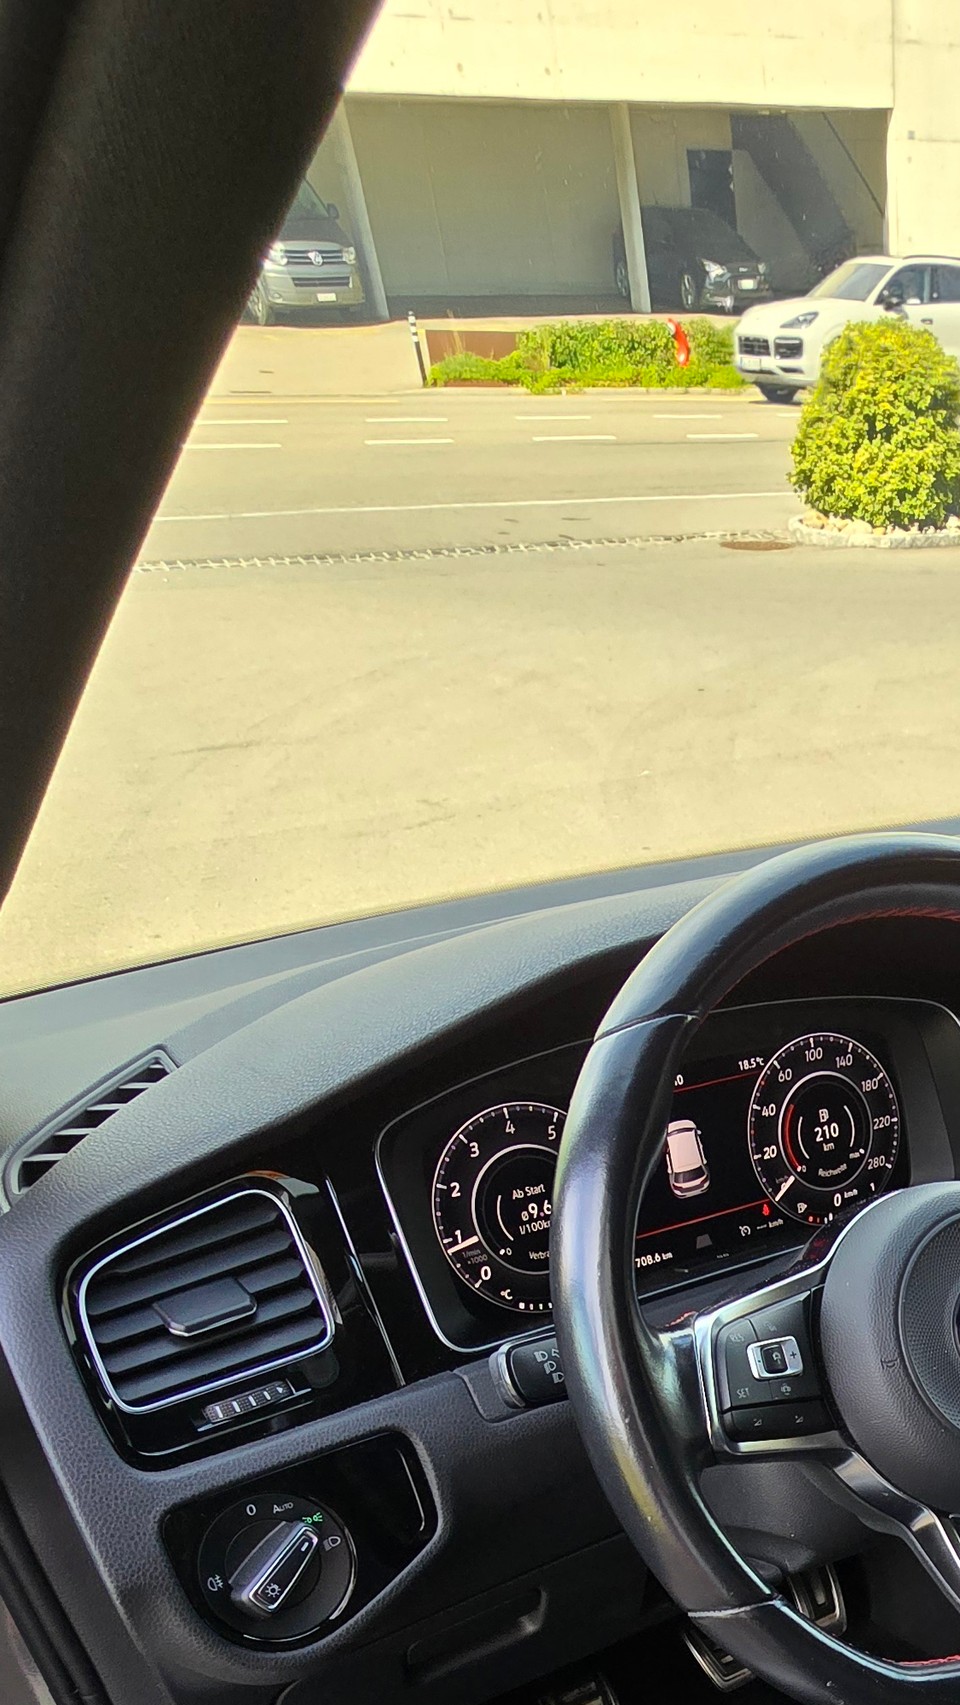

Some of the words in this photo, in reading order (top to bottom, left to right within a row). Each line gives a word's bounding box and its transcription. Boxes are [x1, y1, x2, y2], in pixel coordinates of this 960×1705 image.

[805, 1048, 823, 1062] 100
[835, 1054, 853, 1068] 140
[778, 1068, 793, 1082] 60
[861, 1079, 879, 1092] 180
[761, 1104, 776, 1117] 40
[505, 1121, 515, 1135] 4
[873, 1116, 891, 1130] 220
[548, 1125, 557, 1140] 5
[814, 1123, 840, 1142] 210
[469, 1142, 480, 1158] 3
[763, 1146, 778, 1159] 20
[823, 1142, 835, 1152] km
[867, 1155, 886, 1170] 280
[450, 1182, 462, 1198] 2
[512, 1189, 524, 1200] Ab
[525, 1184, 546, 1197] Start
[833, 1193, 842, 1207] 0
[454, 1230, 462, 1244] 1
[529, 1251, 550, 1260] Verbra
[635, 1252, 661, 1268] 708.6
[662, 1252, 673, 1261] km
[481, 1265, 492, 1281] 0
[736, 1387, 750, 1399] SET
[246, 1504, 257, 1516] 0
